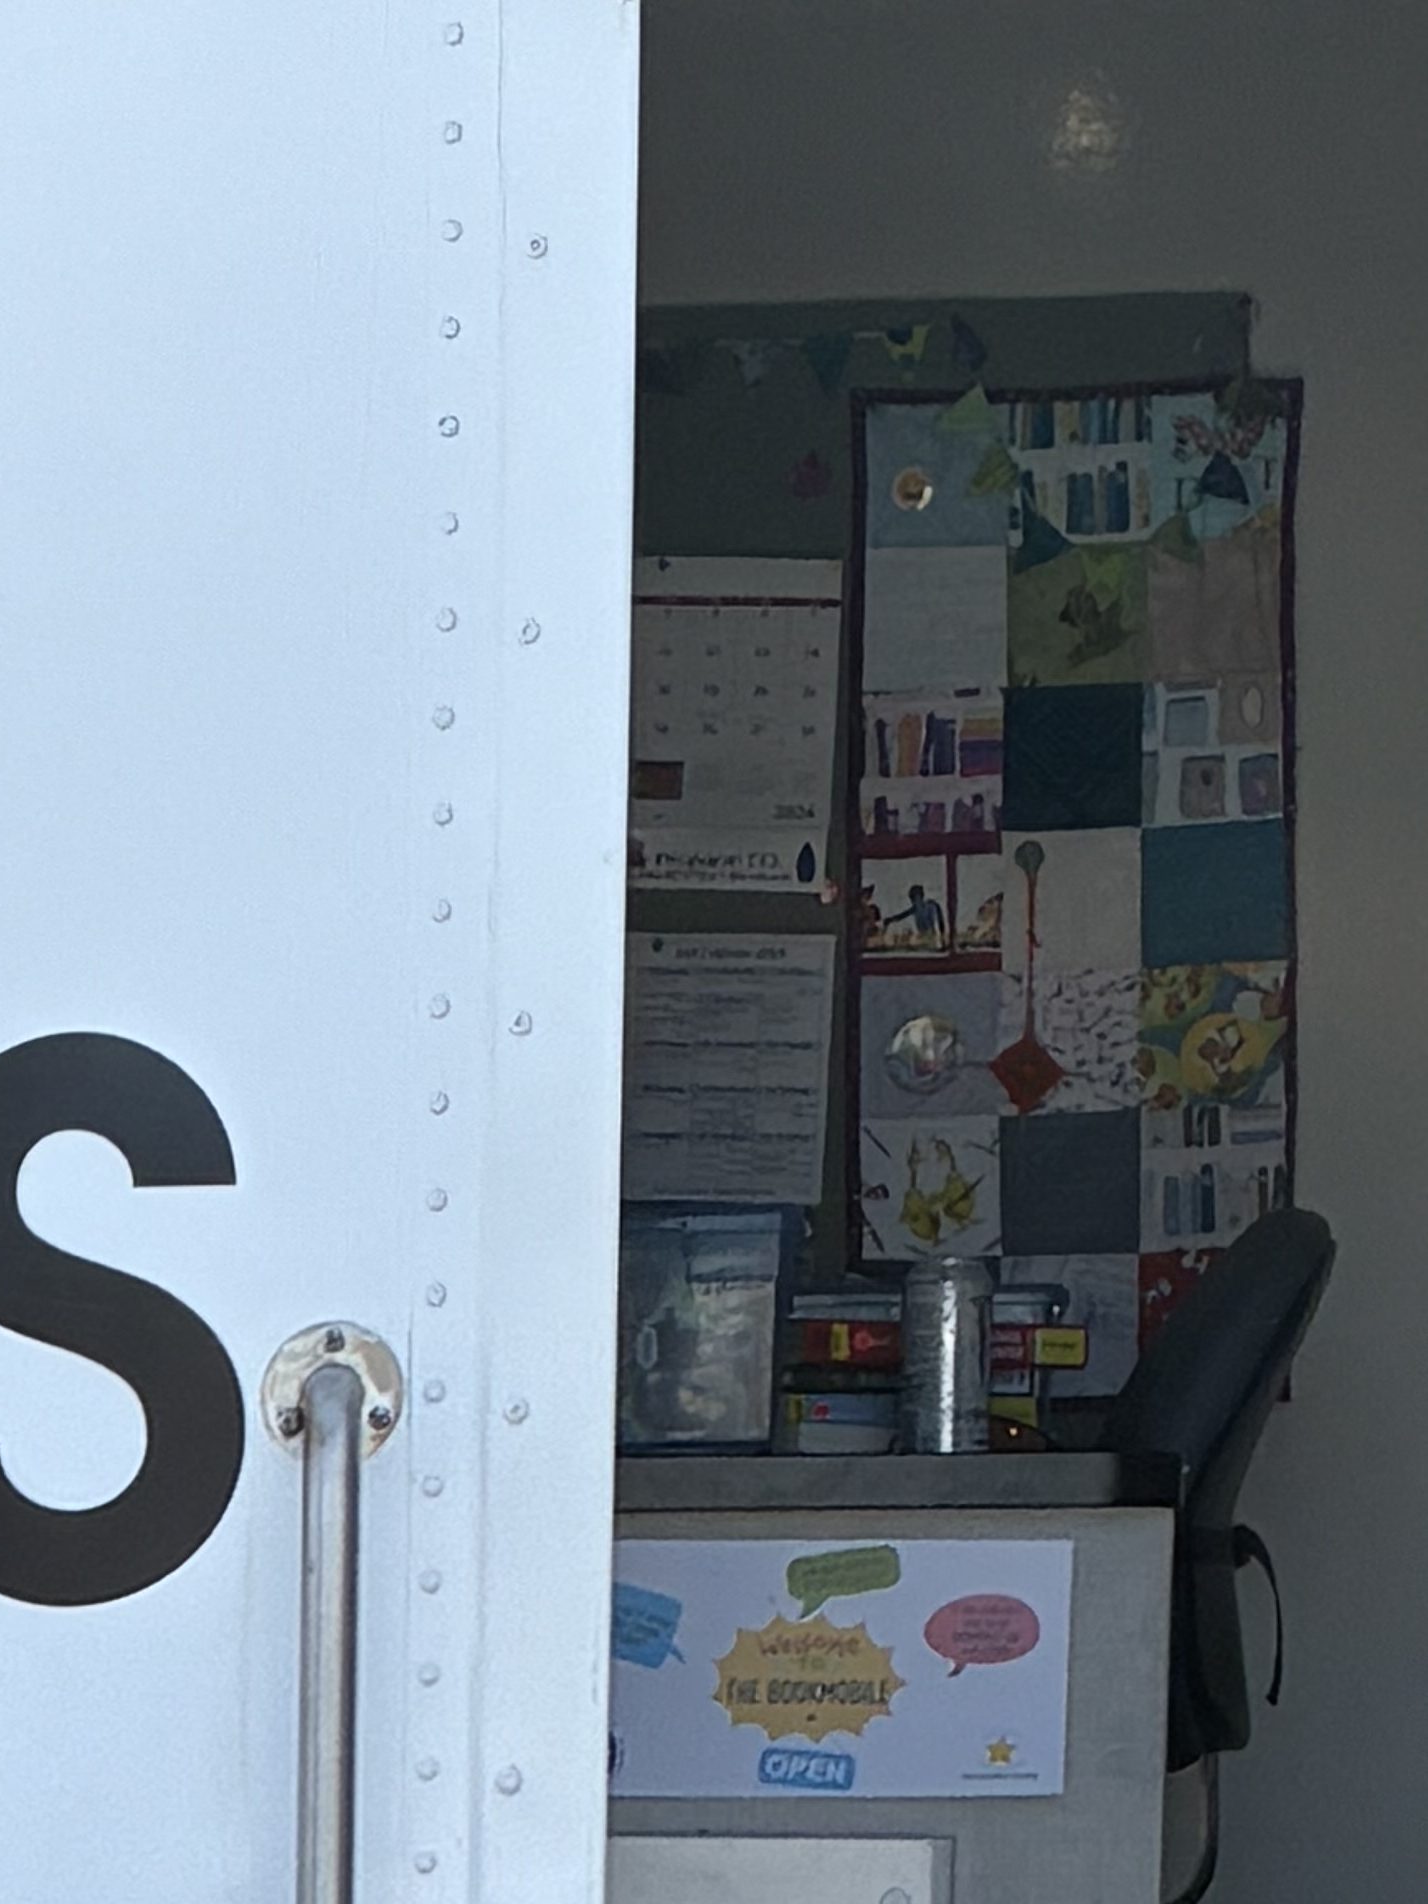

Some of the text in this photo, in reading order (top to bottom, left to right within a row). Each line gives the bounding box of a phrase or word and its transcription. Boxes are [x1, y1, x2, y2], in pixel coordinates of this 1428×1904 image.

[727, 1677, 891, 1705] THE BOOKMOBILE
[764, 1752, 847, 1784] OPEN
